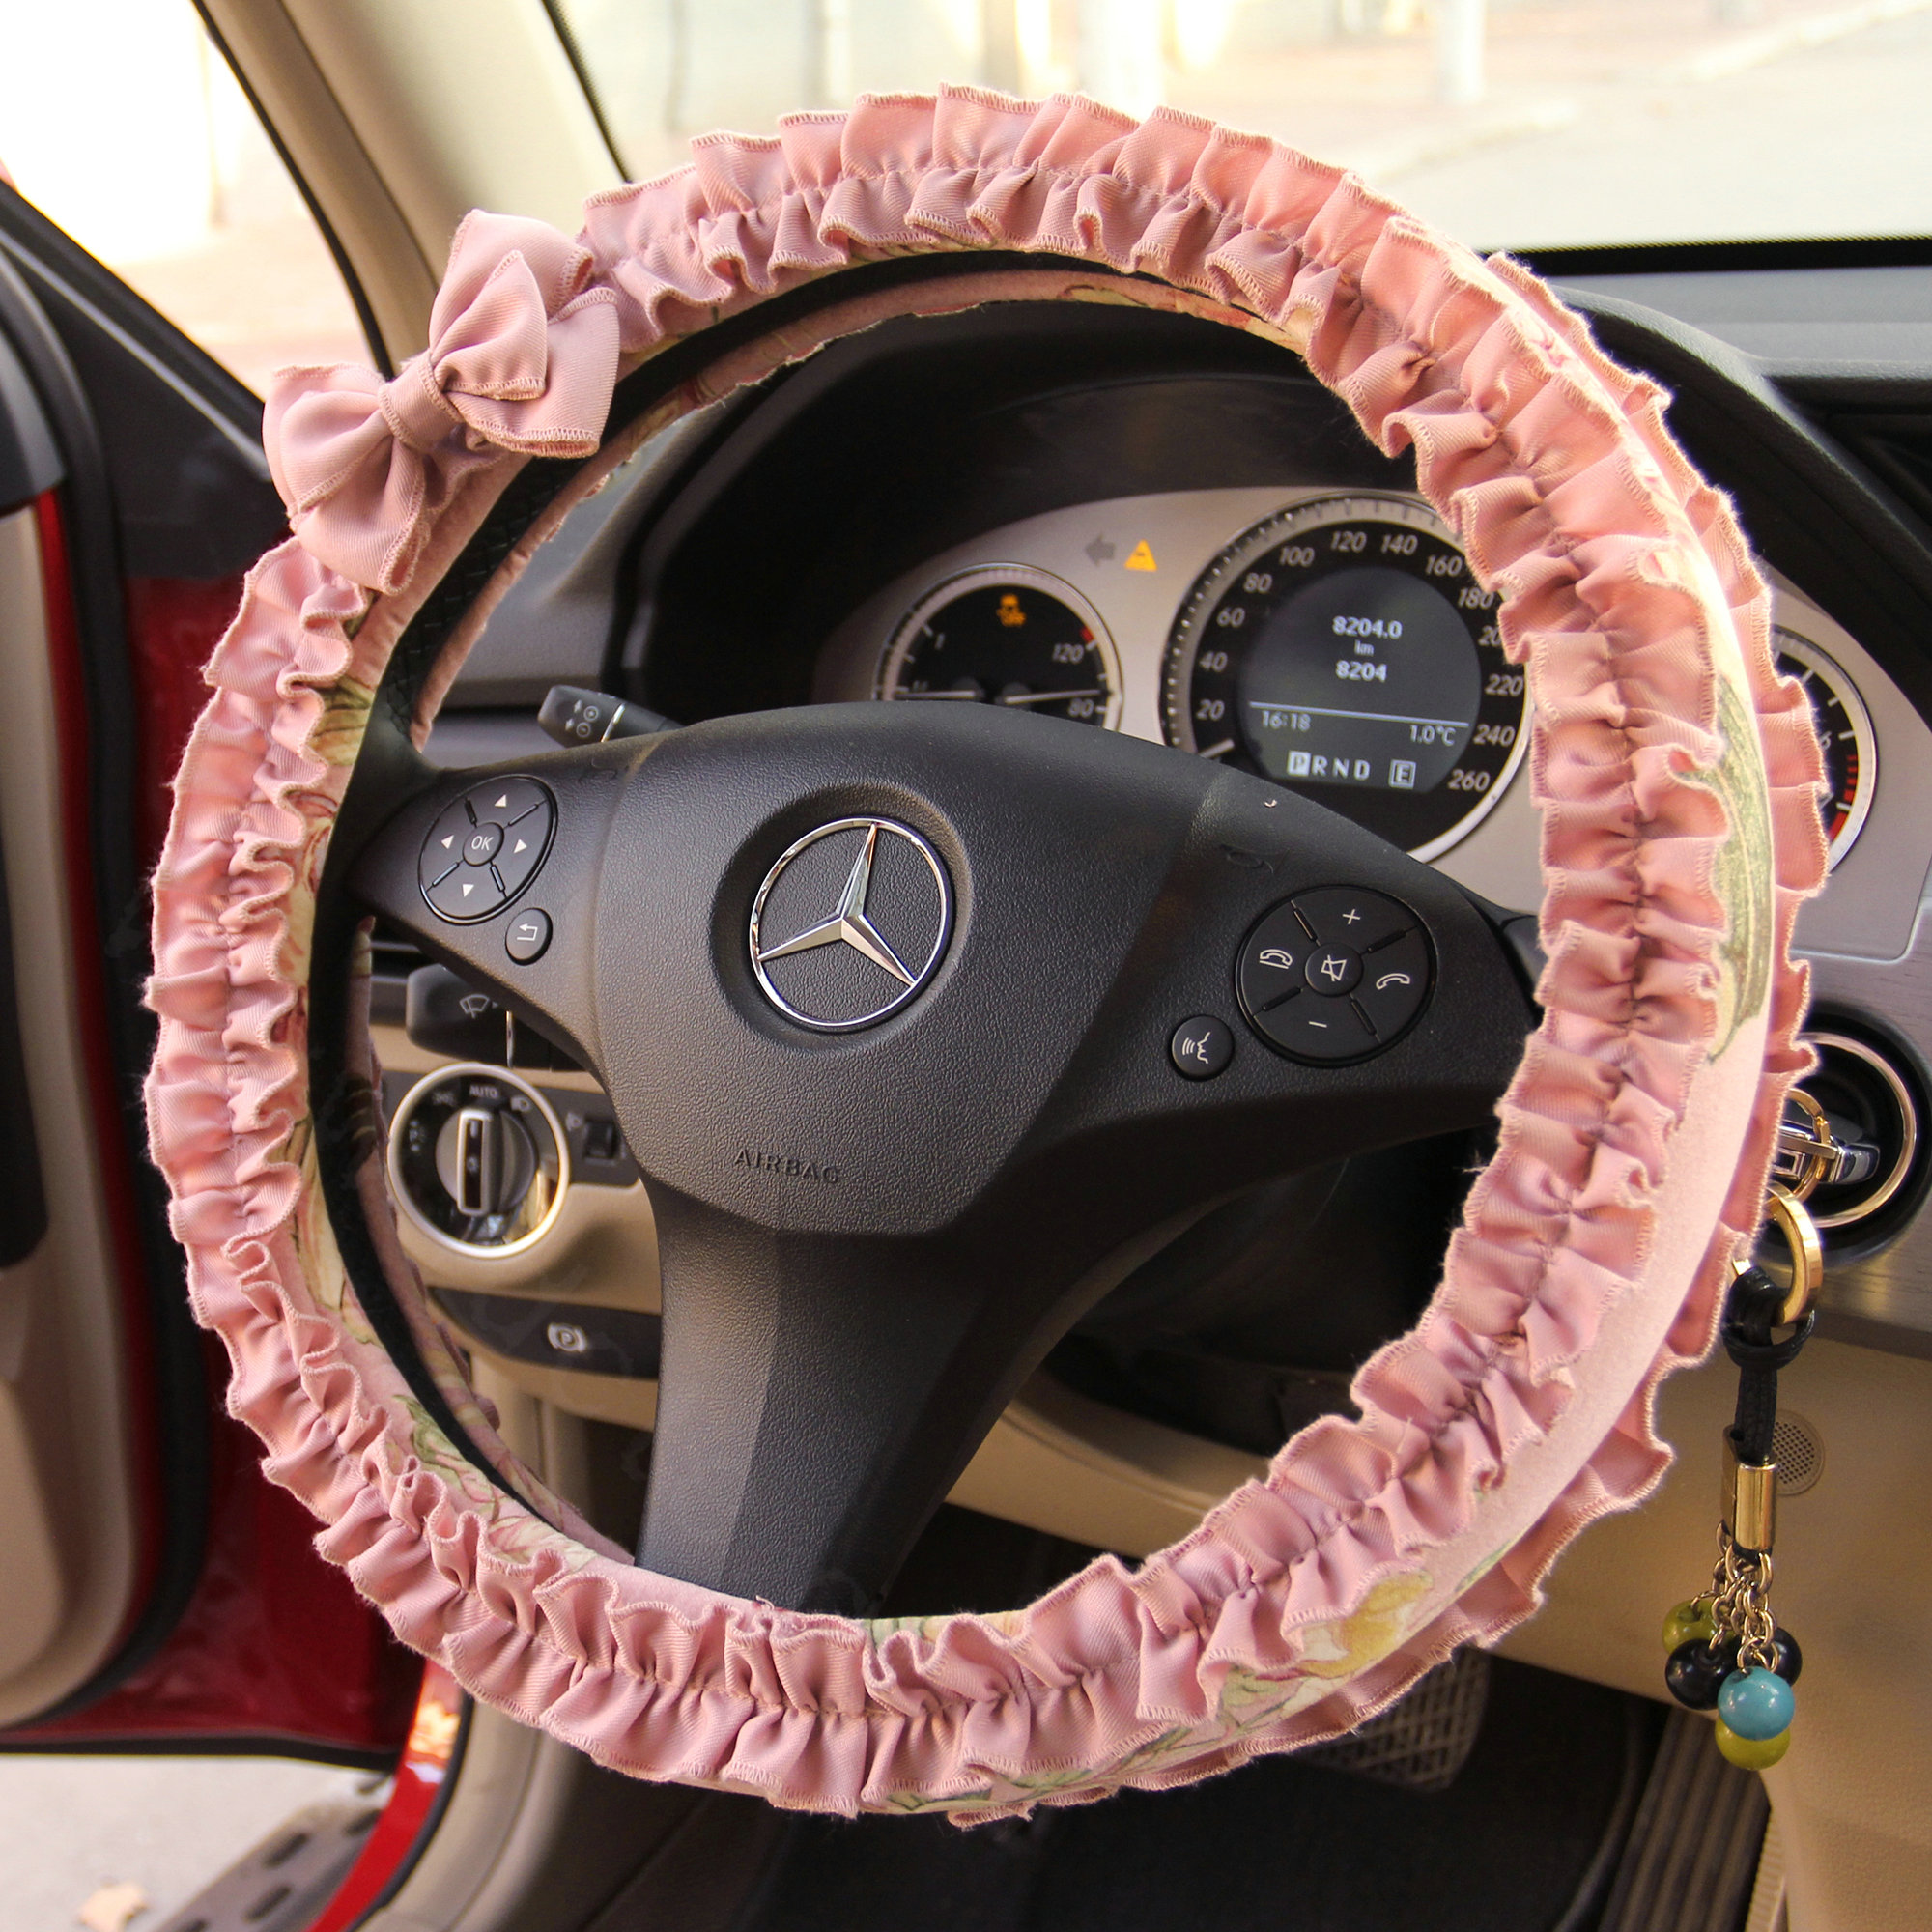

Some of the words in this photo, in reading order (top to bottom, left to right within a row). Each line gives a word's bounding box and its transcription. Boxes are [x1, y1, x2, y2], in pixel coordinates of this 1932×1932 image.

[1330, 532, 1367, 553] 120
[1381, 534, 1418, 555] 140
[1279, 546, 1315, 567] 100
[1425, 554, 1463, 577] 160
[1243, 572, 1273, 594] 80
[1457, 587, 1494, 609] 180
[1216, 607, 1245, 628] 60
[1332, 615, 1403, 639] 8204.0
[1052, 643, 1084, 665] 120
[1199, 651, 1228, 672] 40
[1335, 660, 1387, 683] 8204
[1486, 674, 1523, 696] 220
[1196, 698, 1225, 721] 20
[1262, 710, 1311, 732] 16:18
[1473, 724, 1515, 747] 240
[1447, 769, 1490, 792] 260
[471, 836, 494, 851] OK
[469, 1084, 499, 1099] AUTO
[734, 1148, 840, 1184] AIRBAG
